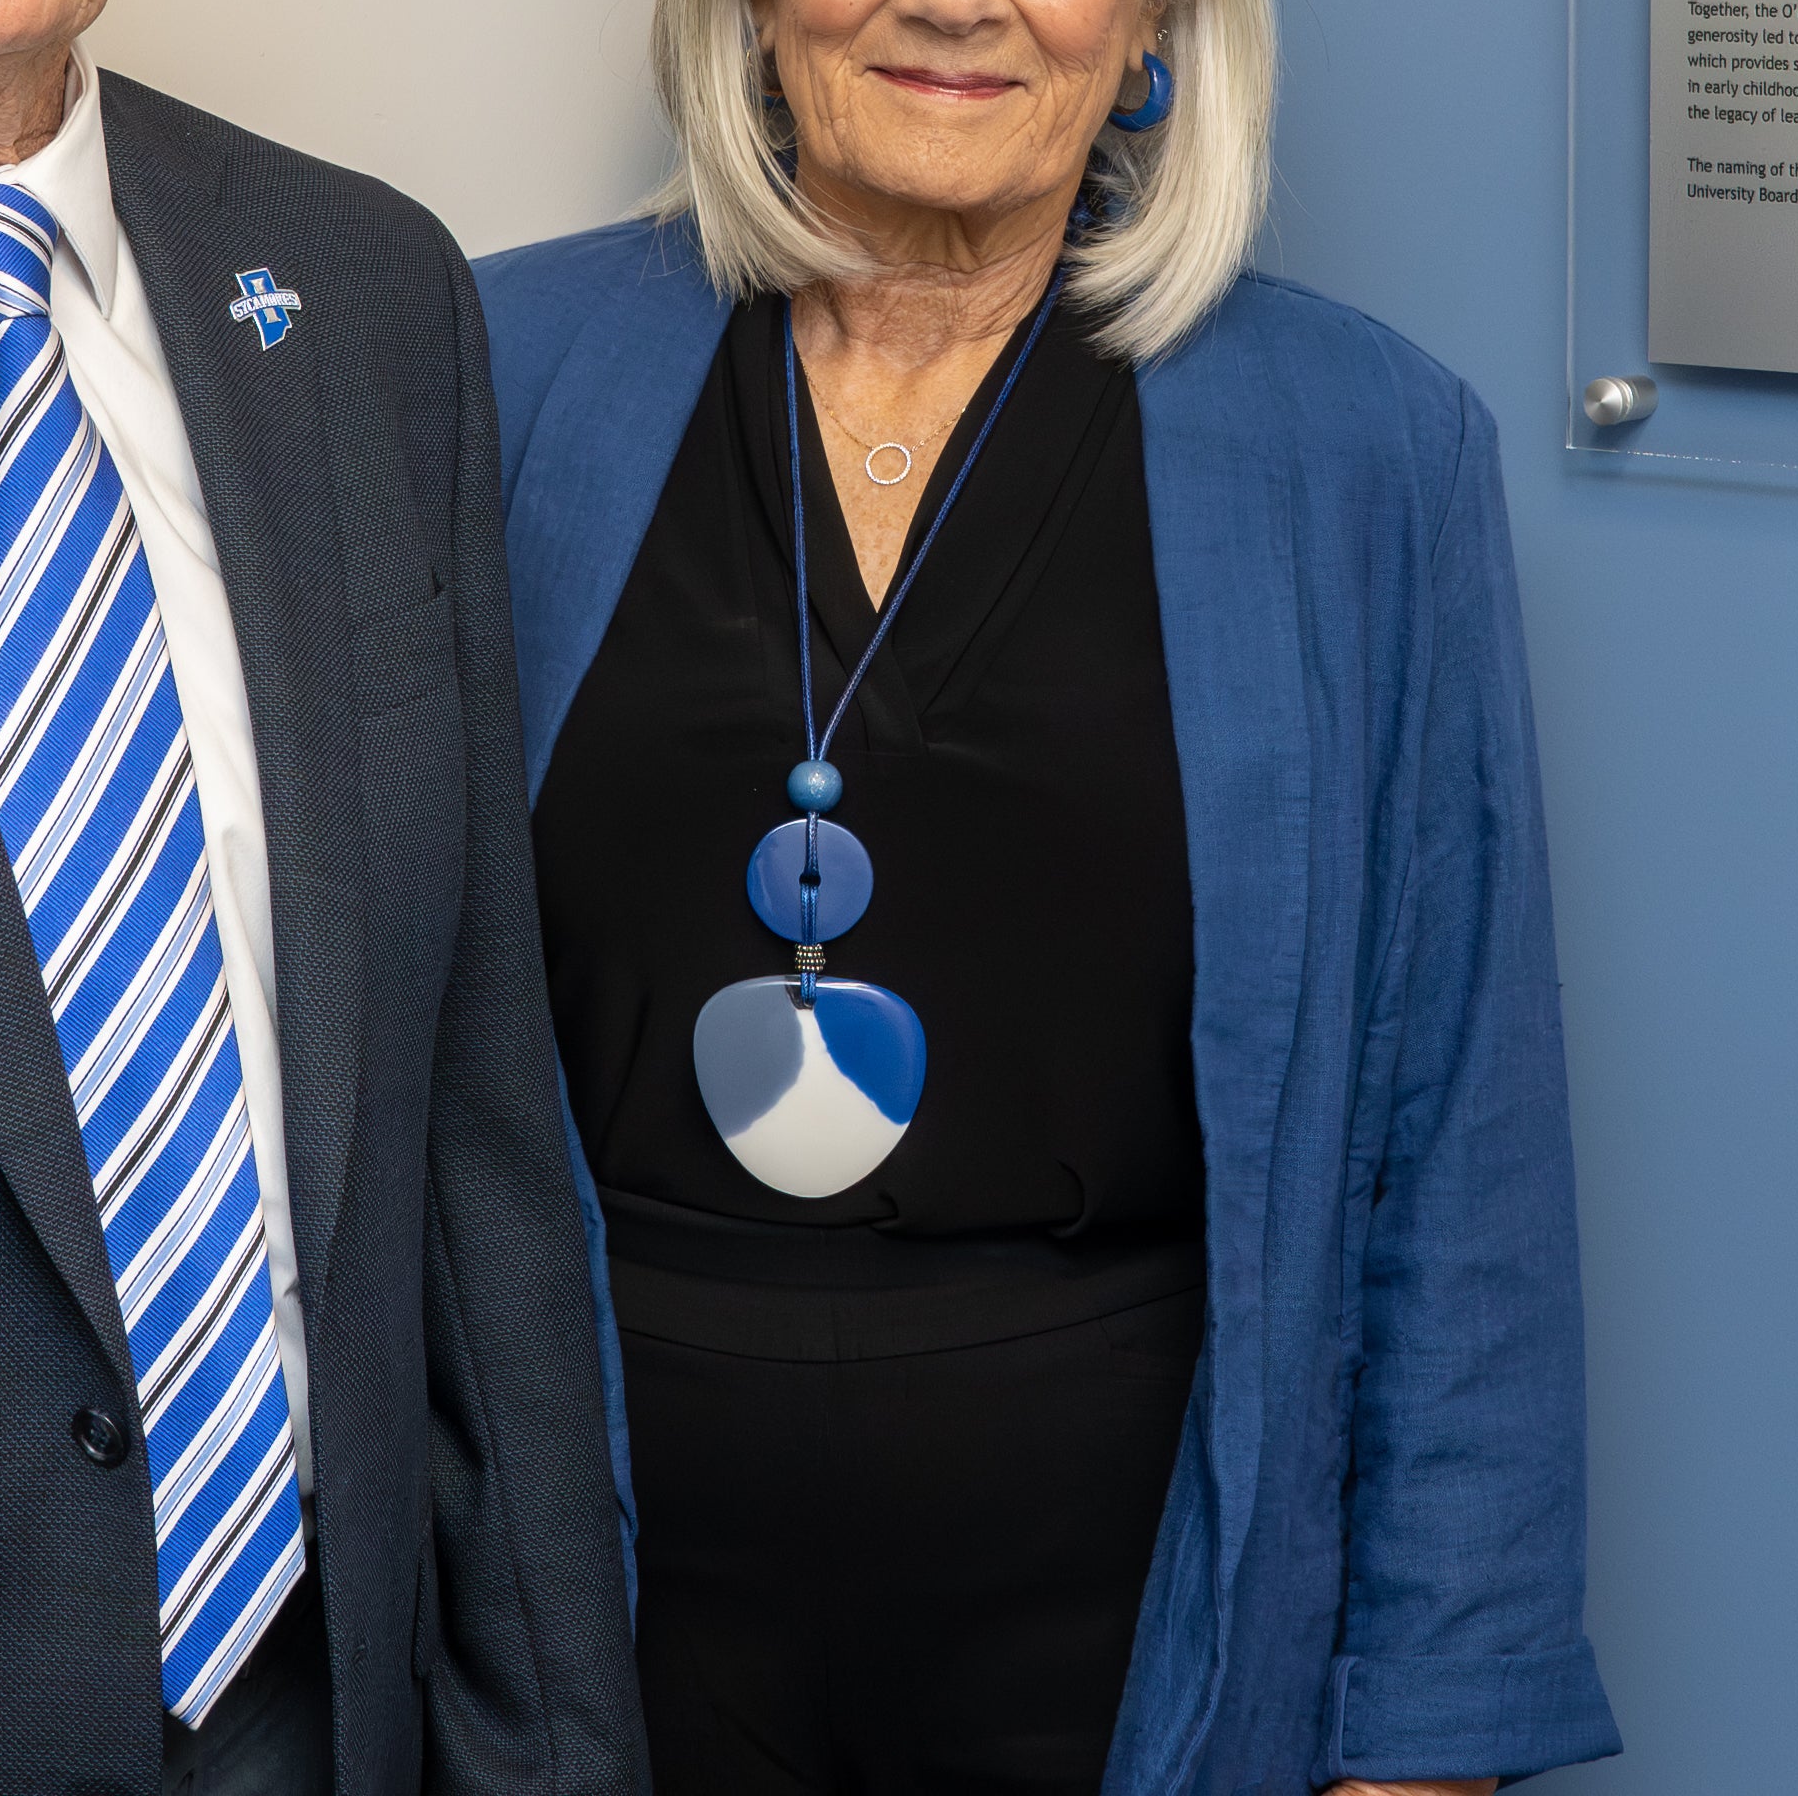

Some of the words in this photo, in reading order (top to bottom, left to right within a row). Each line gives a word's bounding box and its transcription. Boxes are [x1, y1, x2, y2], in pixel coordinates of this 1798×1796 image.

[1686, 52, 1727, 69] which
[1731, 53, 1791, 73] provides
[1687, 103, 1711, 120] the
[1714, 104, 1759, 126] legacy
[1761, 107, 1777, 123] of
[1686, 182, 1756, 205] University
[1759, 185, 1798, 204] Board
[233, 293, 298, 317] SYCAMORES
